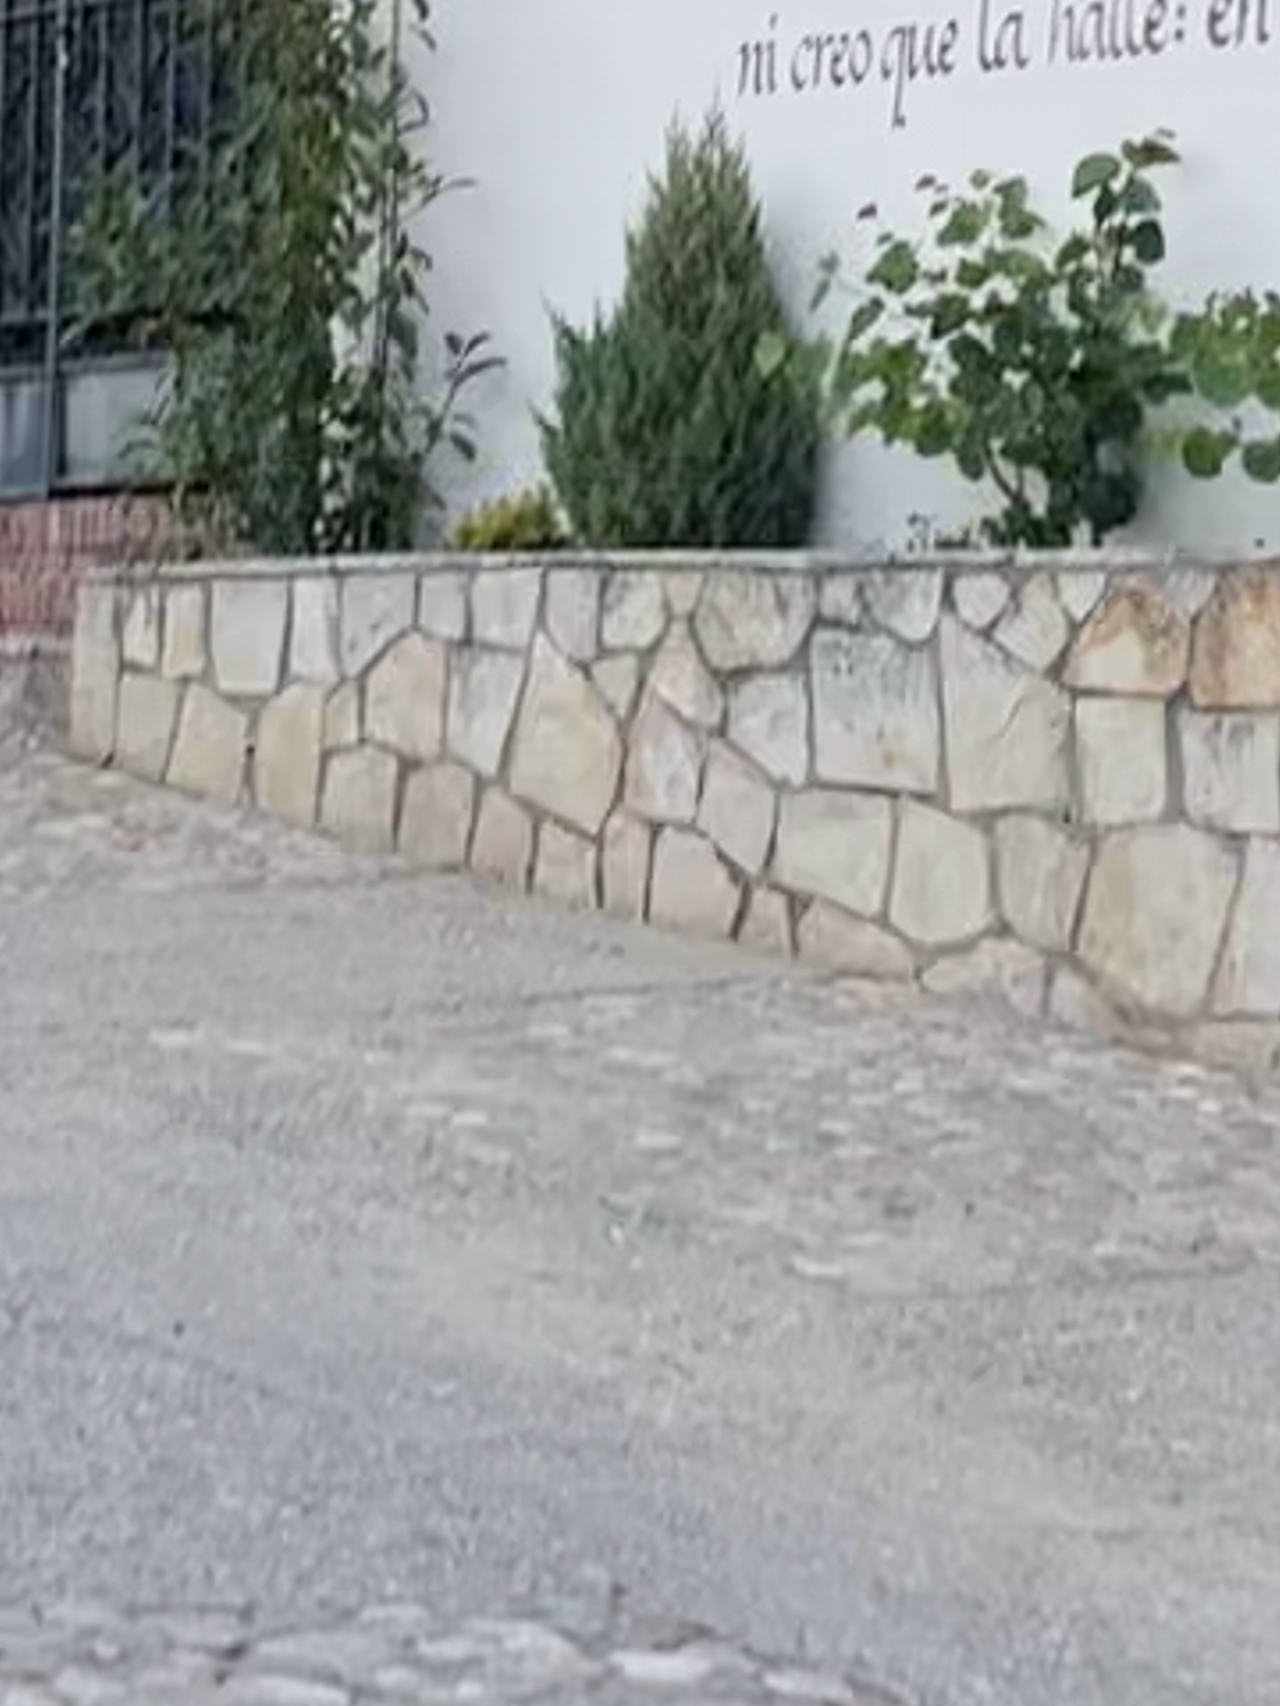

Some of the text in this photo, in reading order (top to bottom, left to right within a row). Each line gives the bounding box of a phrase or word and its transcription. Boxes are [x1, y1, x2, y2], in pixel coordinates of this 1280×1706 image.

[736, 14, 778, 97] ni
[790, 29, 873, 94] creo
[879, 18, 960, 129] que
